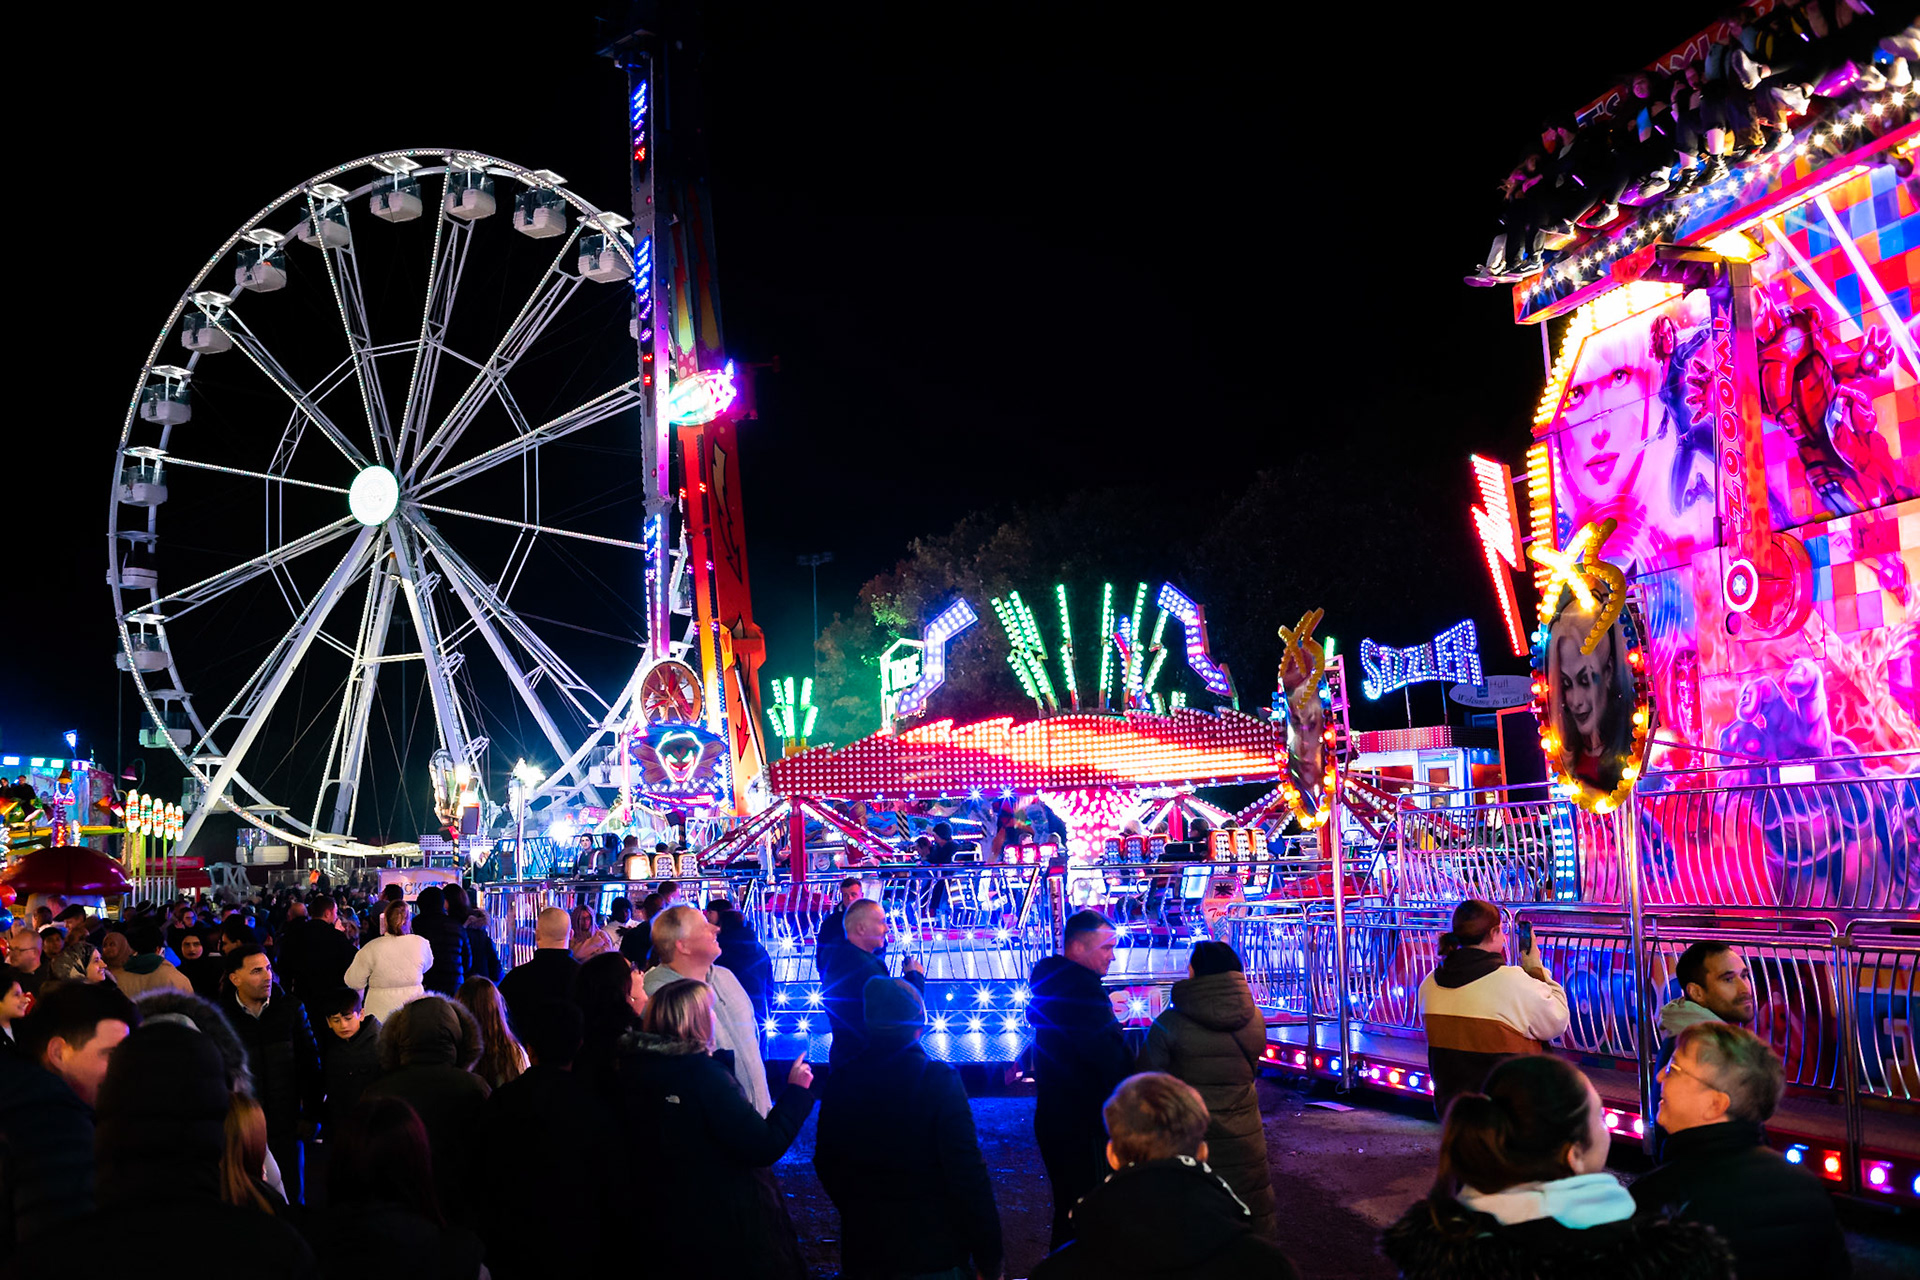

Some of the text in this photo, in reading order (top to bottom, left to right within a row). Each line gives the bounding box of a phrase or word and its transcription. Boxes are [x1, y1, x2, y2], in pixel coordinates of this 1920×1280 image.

[1489, 679, 1509, 688] Hull
[1457, 693, 1489, 706] Welcome
[1501, 696, 1520, 705] West
